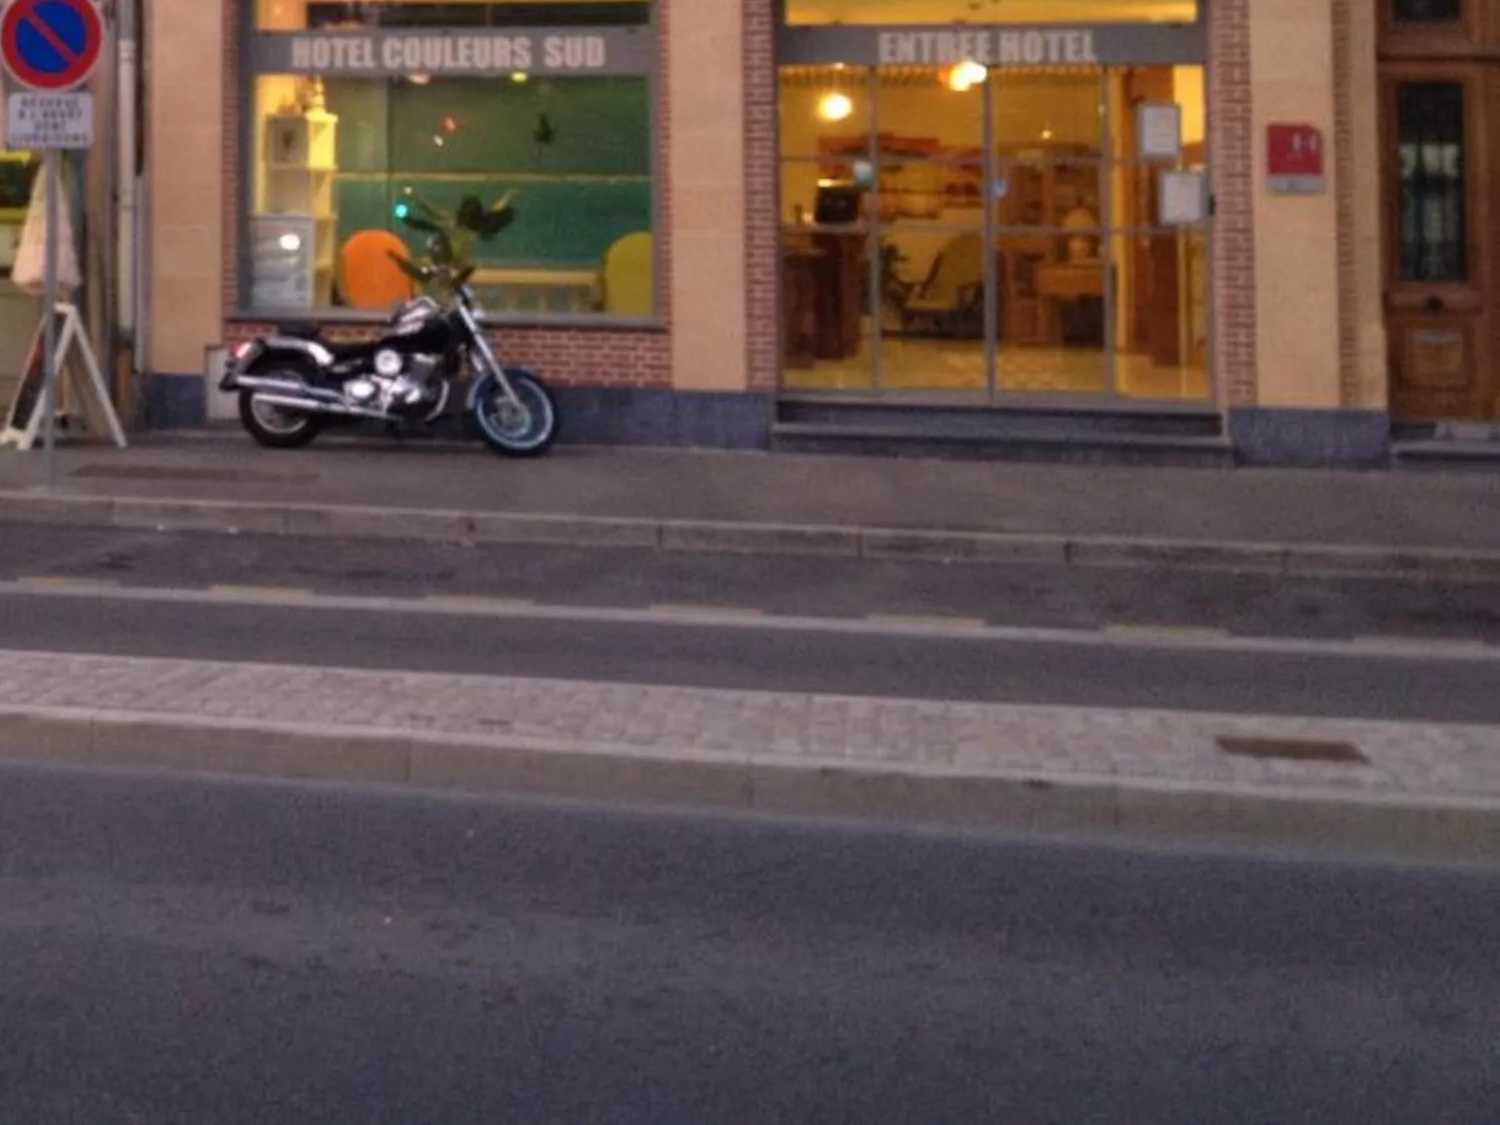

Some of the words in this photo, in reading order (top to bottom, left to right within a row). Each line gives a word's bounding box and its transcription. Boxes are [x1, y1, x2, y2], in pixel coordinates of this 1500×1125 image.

[291, 36, 376, 69] HOTEL
[382, 36, 533, 69] COULEURS
[544, 36, 606, 69] SUD
[999, 29, 1098, 63] HOTEL
